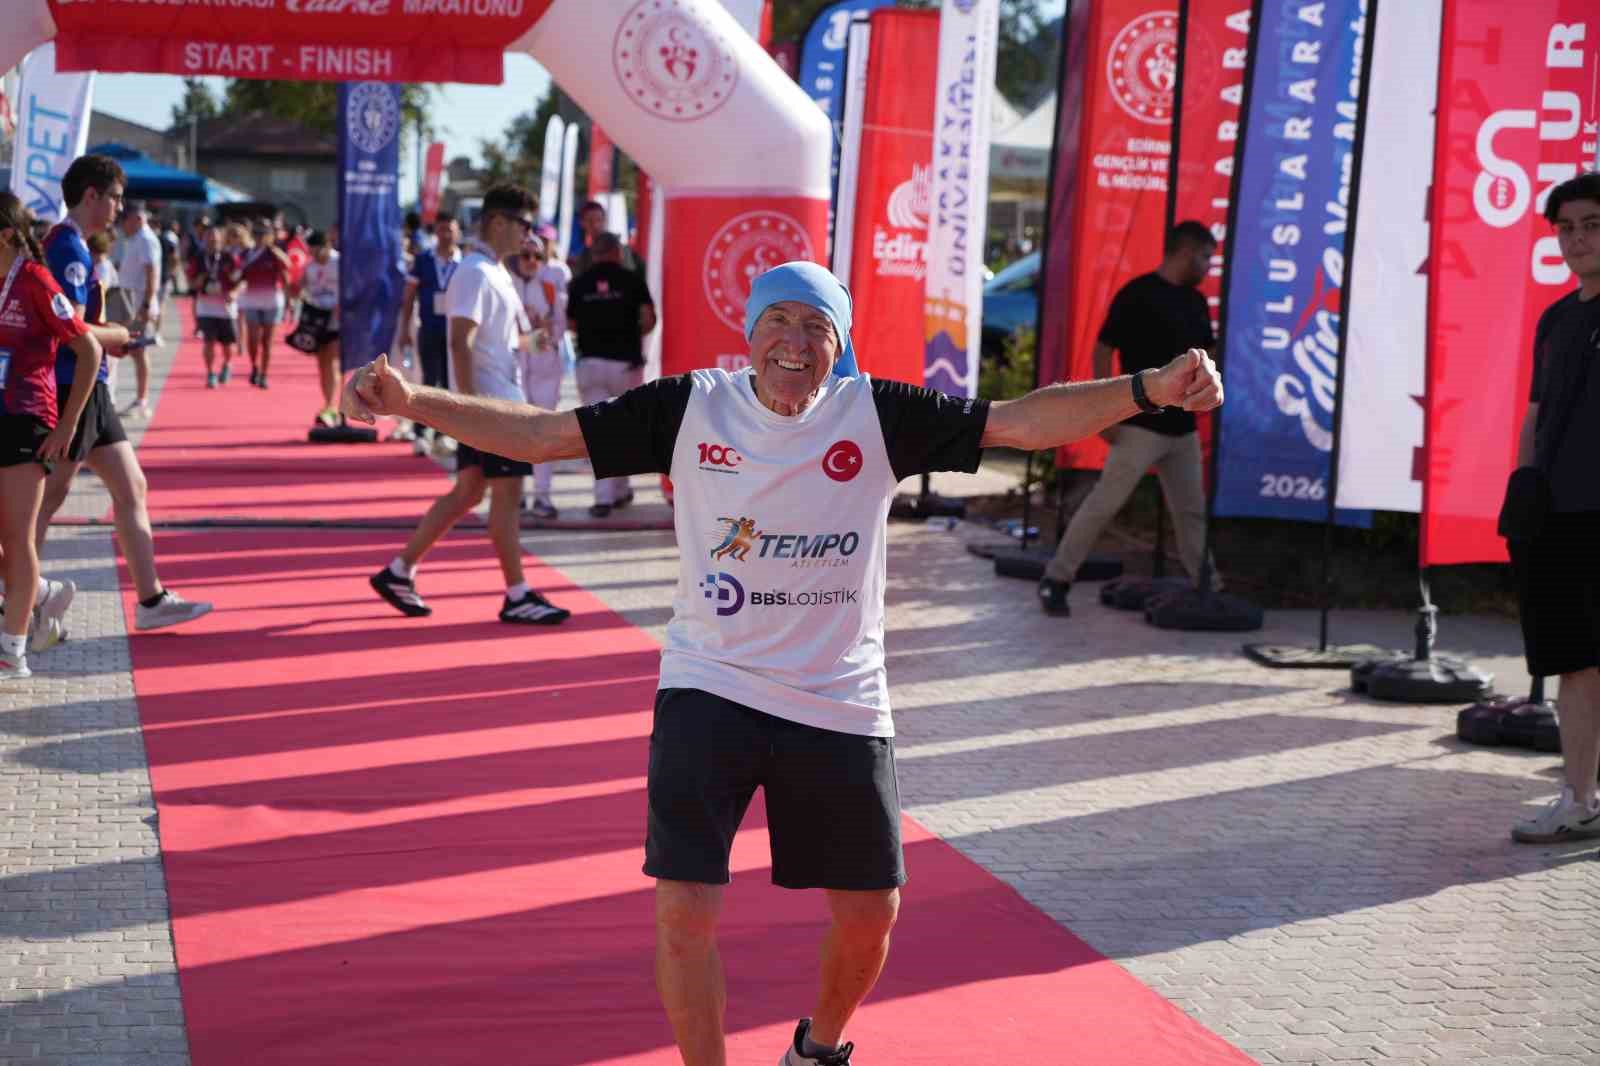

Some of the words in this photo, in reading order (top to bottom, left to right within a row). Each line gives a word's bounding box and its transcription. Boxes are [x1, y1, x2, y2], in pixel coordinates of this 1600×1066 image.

[184, 42, 273, 71] START
[300, 45, 393, 75] FINISH
[1127, 137, 1171, 154] EDİRN
[1260, 473, 1326, 501] 2026
[758, 531, 860, 559] TEMPO
